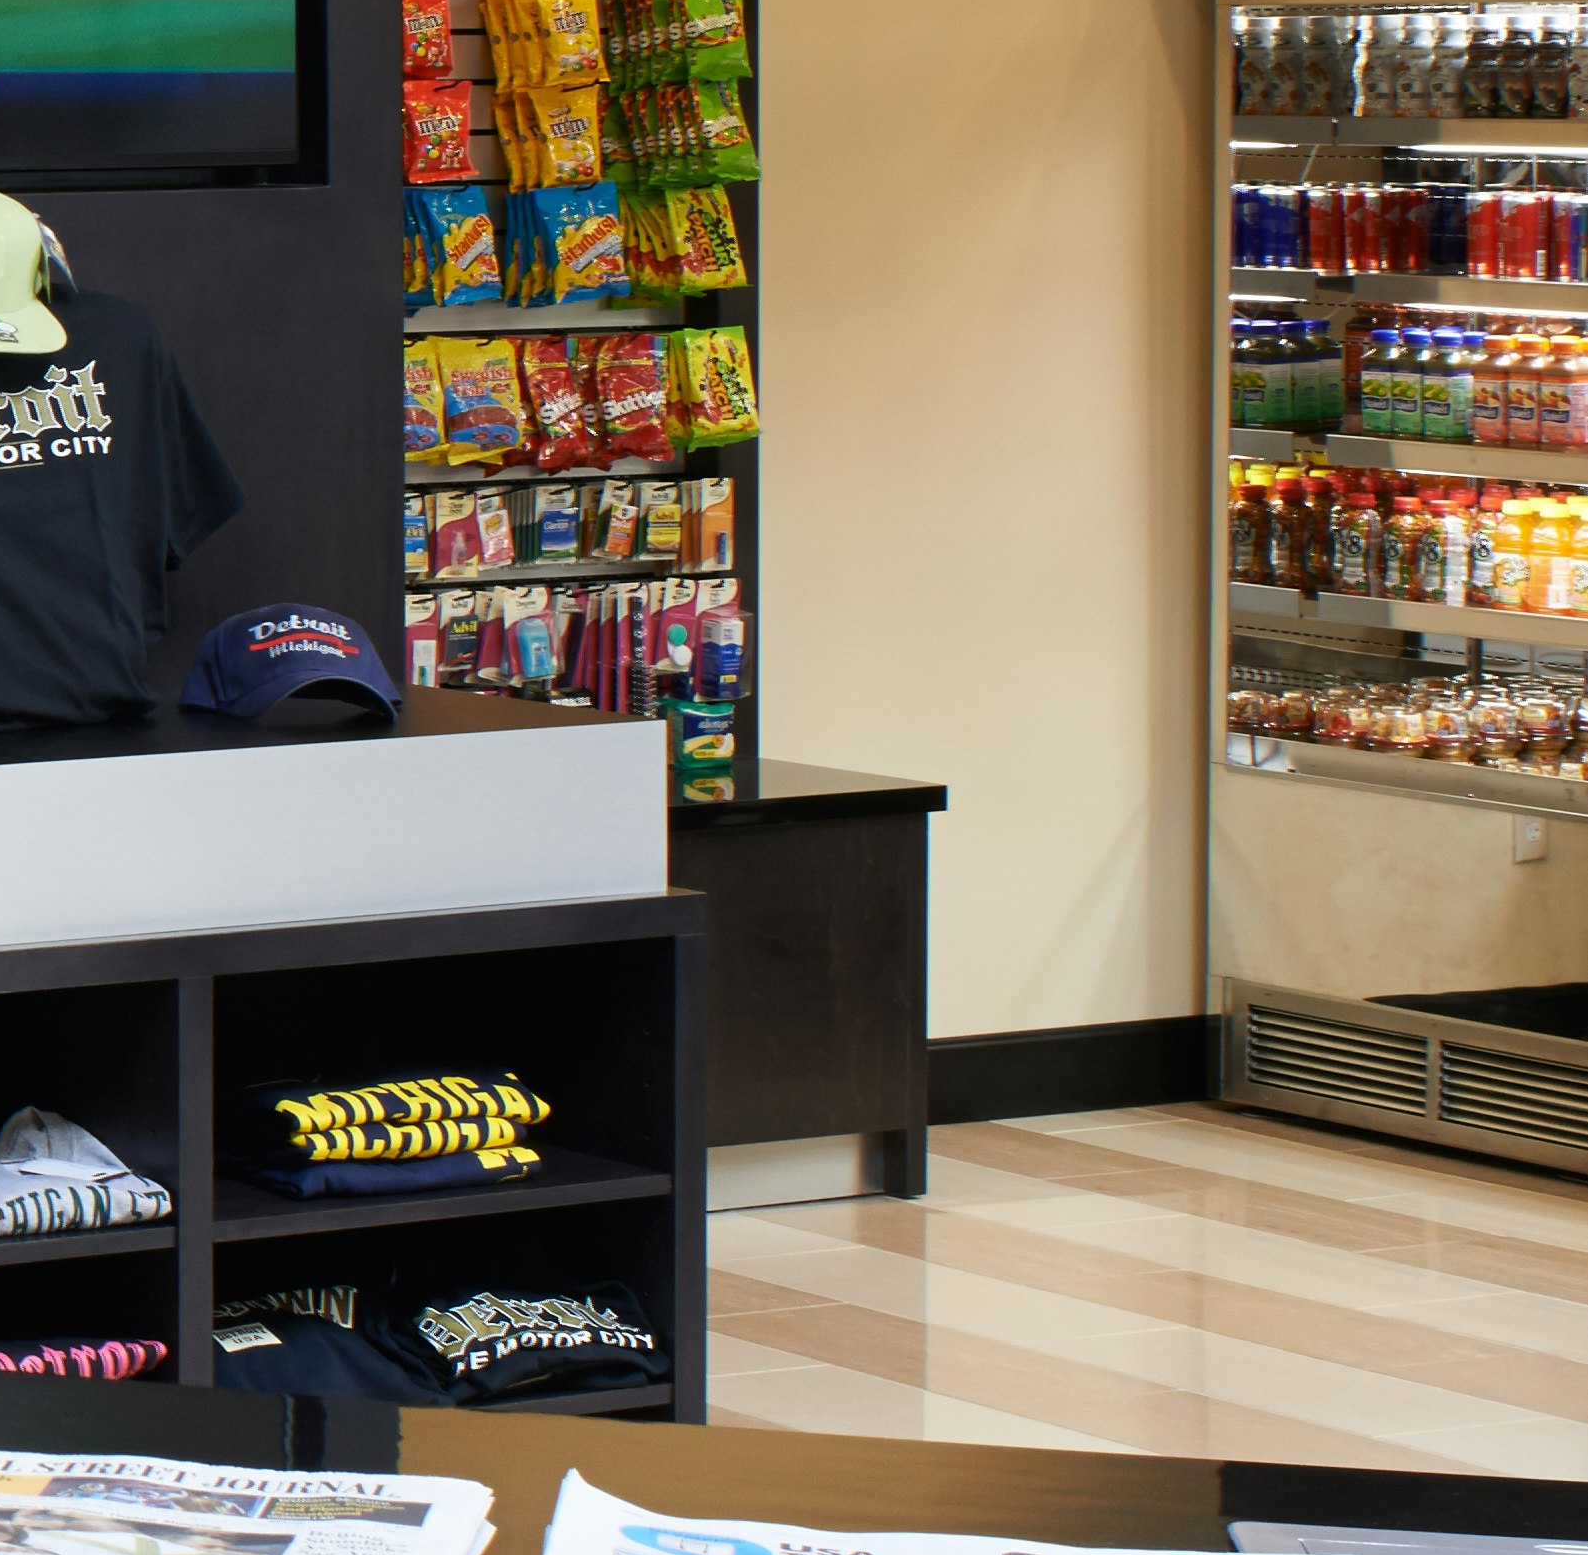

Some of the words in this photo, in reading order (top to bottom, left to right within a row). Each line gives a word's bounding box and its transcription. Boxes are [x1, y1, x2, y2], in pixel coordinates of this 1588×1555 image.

[51, 436, 112, 457] CITY
[248, 615, 352, 640] Detroit
[450, 620, 477, 635] Advil
[496, 1331, 591, 1358] MOTOR
[33, 1460, 199, 1484] STREET
[202, 1476, 400, 1498] JOURNAL.
